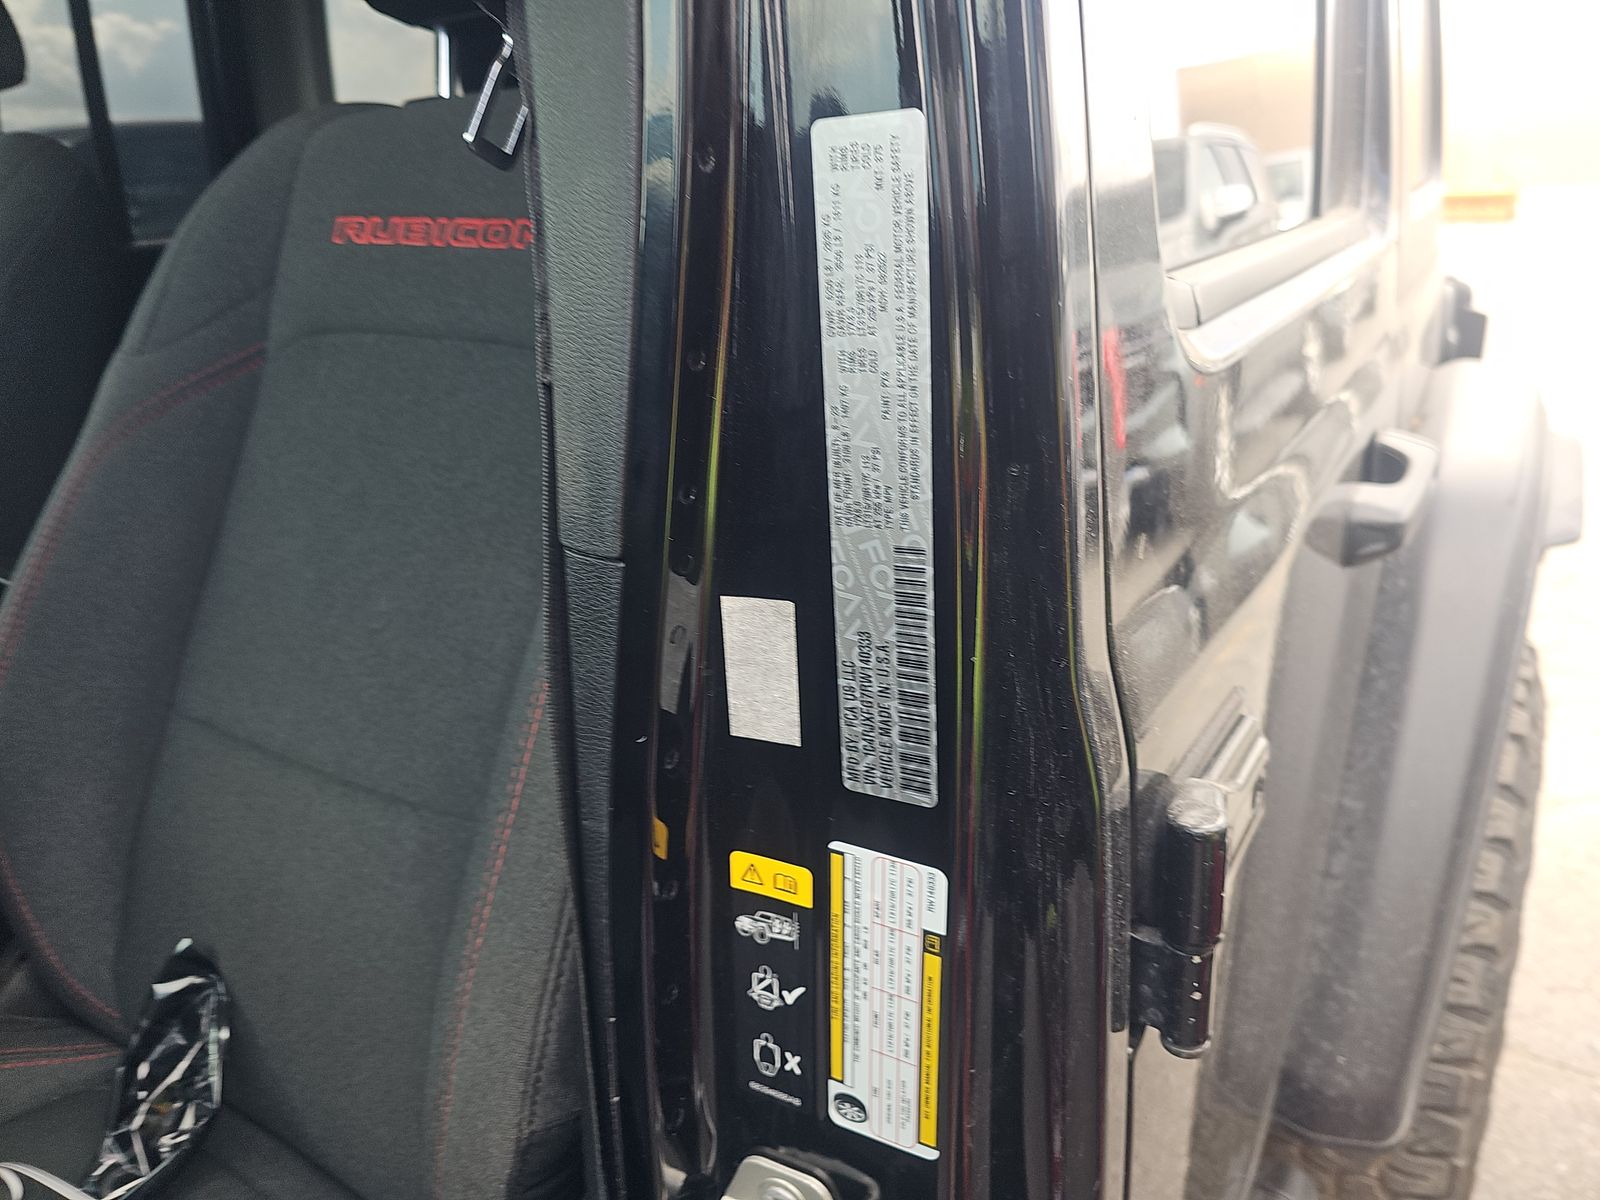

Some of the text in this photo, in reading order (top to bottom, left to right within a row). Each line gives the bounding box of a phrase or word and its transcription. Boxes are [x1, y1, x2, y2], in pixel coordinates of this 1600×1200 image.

[907, 321, 917, 334] OF
[907, 335, 918, 361] DATE
[895, 334, 906, 389] APPLICABLE
[907, 363, 918, 382] THE
[896, 391, 907, 408] ALL
[908, 385, 918, 398] ON
[897, 411, 907, 422] TO
[908, 401, 919, 433] EFFECT
[897, 425, 908, 473] CONFORMS
[909, 436, 919, 445] IN
[909, 448, 920, 500] STANDARDS
[834, 491, 843, 502] OF
[884, 484, 893, 503] MPV
[899, 474, 909, 509] VEHICLE
[835, 504, 844, 527] DATE
[874, 518, 883, 529] AT
[900, 512, 909, 530] THIS
[841, 659, 860, 782] MFD BY: FCA US LLC
[875, 639, 893, 789] VEHICLE MADE IN: U.S.A.
[863, 761, 877, 785] VIN:
[831, 912, 839, 958] INFORMATION
